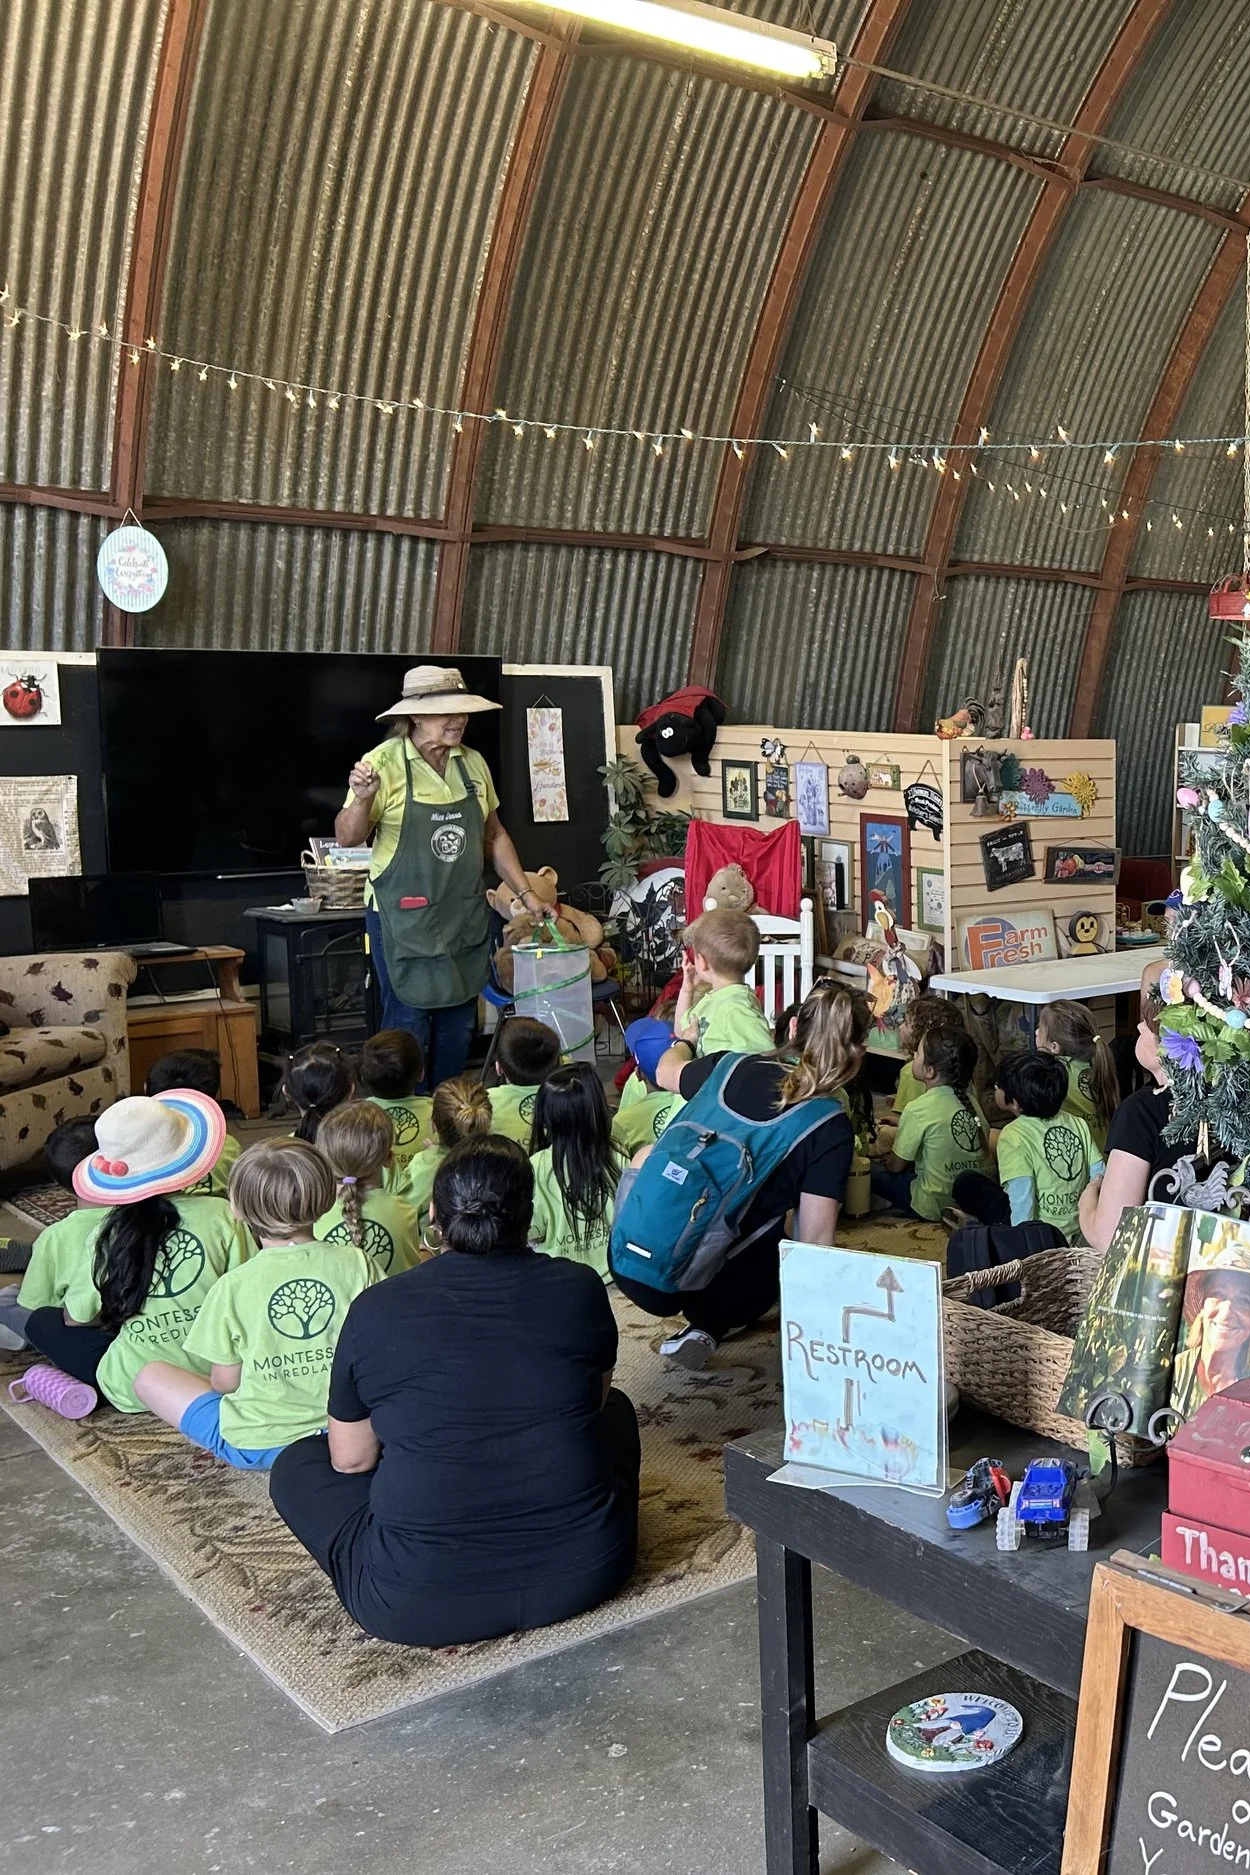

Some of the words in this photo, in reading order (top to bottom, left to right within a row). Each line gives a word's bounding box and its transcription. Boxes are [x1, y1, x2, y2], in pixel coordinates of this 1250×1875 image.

[263, 1371, 278, 1381] IN
[284, 1361, 334, 1378] REDLA
[786, 1321, 927, 1384] RESTROOM
[1148, 1791, 1250, 1869] Garden
